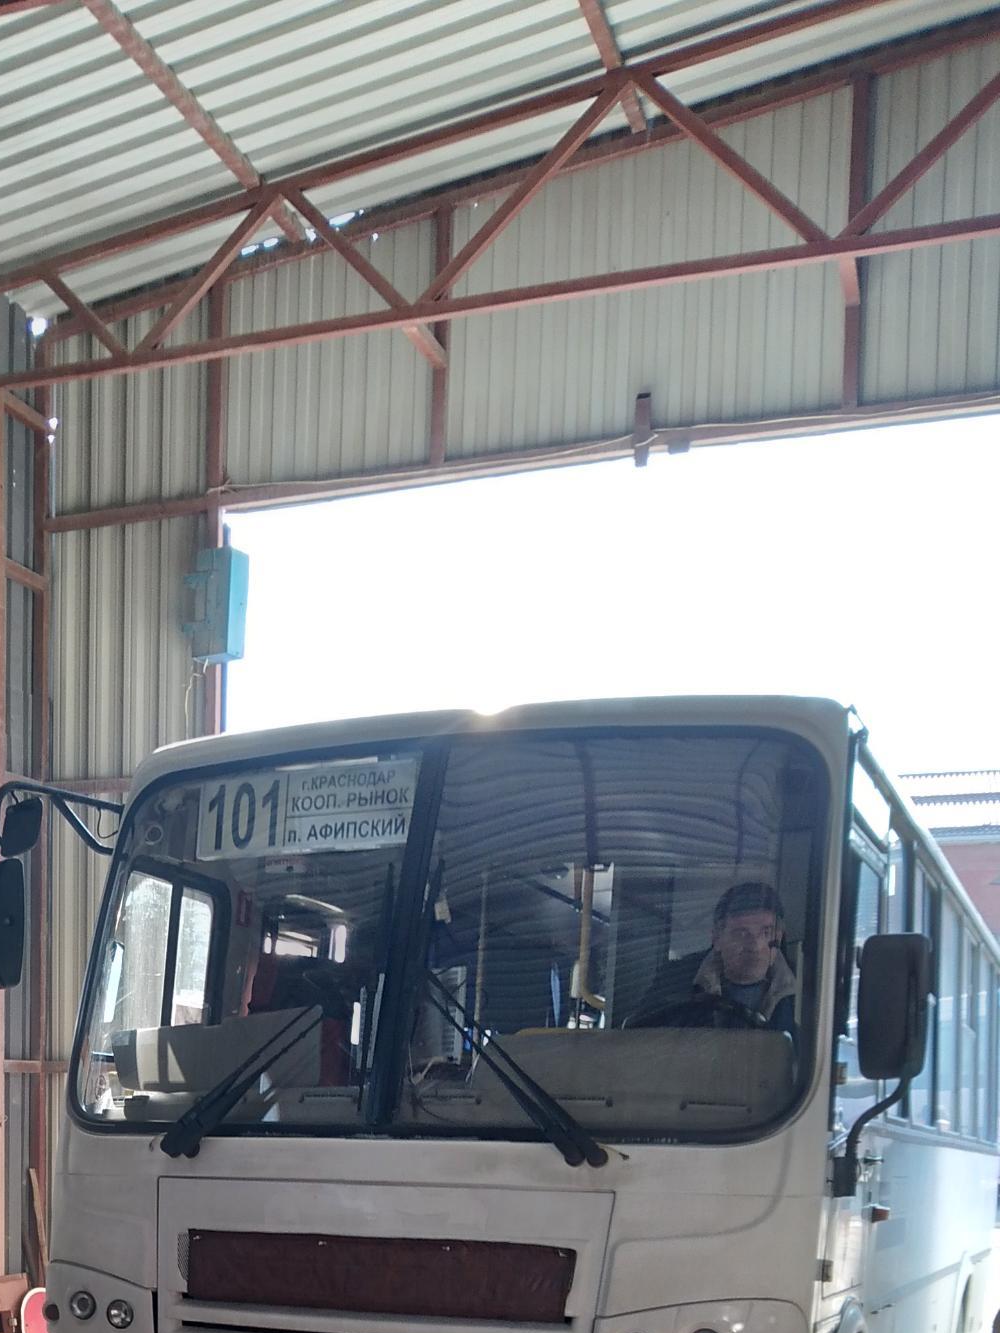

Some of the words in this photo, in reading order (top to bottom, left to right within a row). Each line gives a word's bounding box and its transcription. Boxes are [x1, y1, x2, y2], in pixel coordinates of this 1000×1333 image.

[291, 794, 342, 813] КООП.
[346, 787, 410, 808] РЫНОК
[208, 779, 281, 851] 101
[306, 813, 406, 842] АФИПСКИЙ
